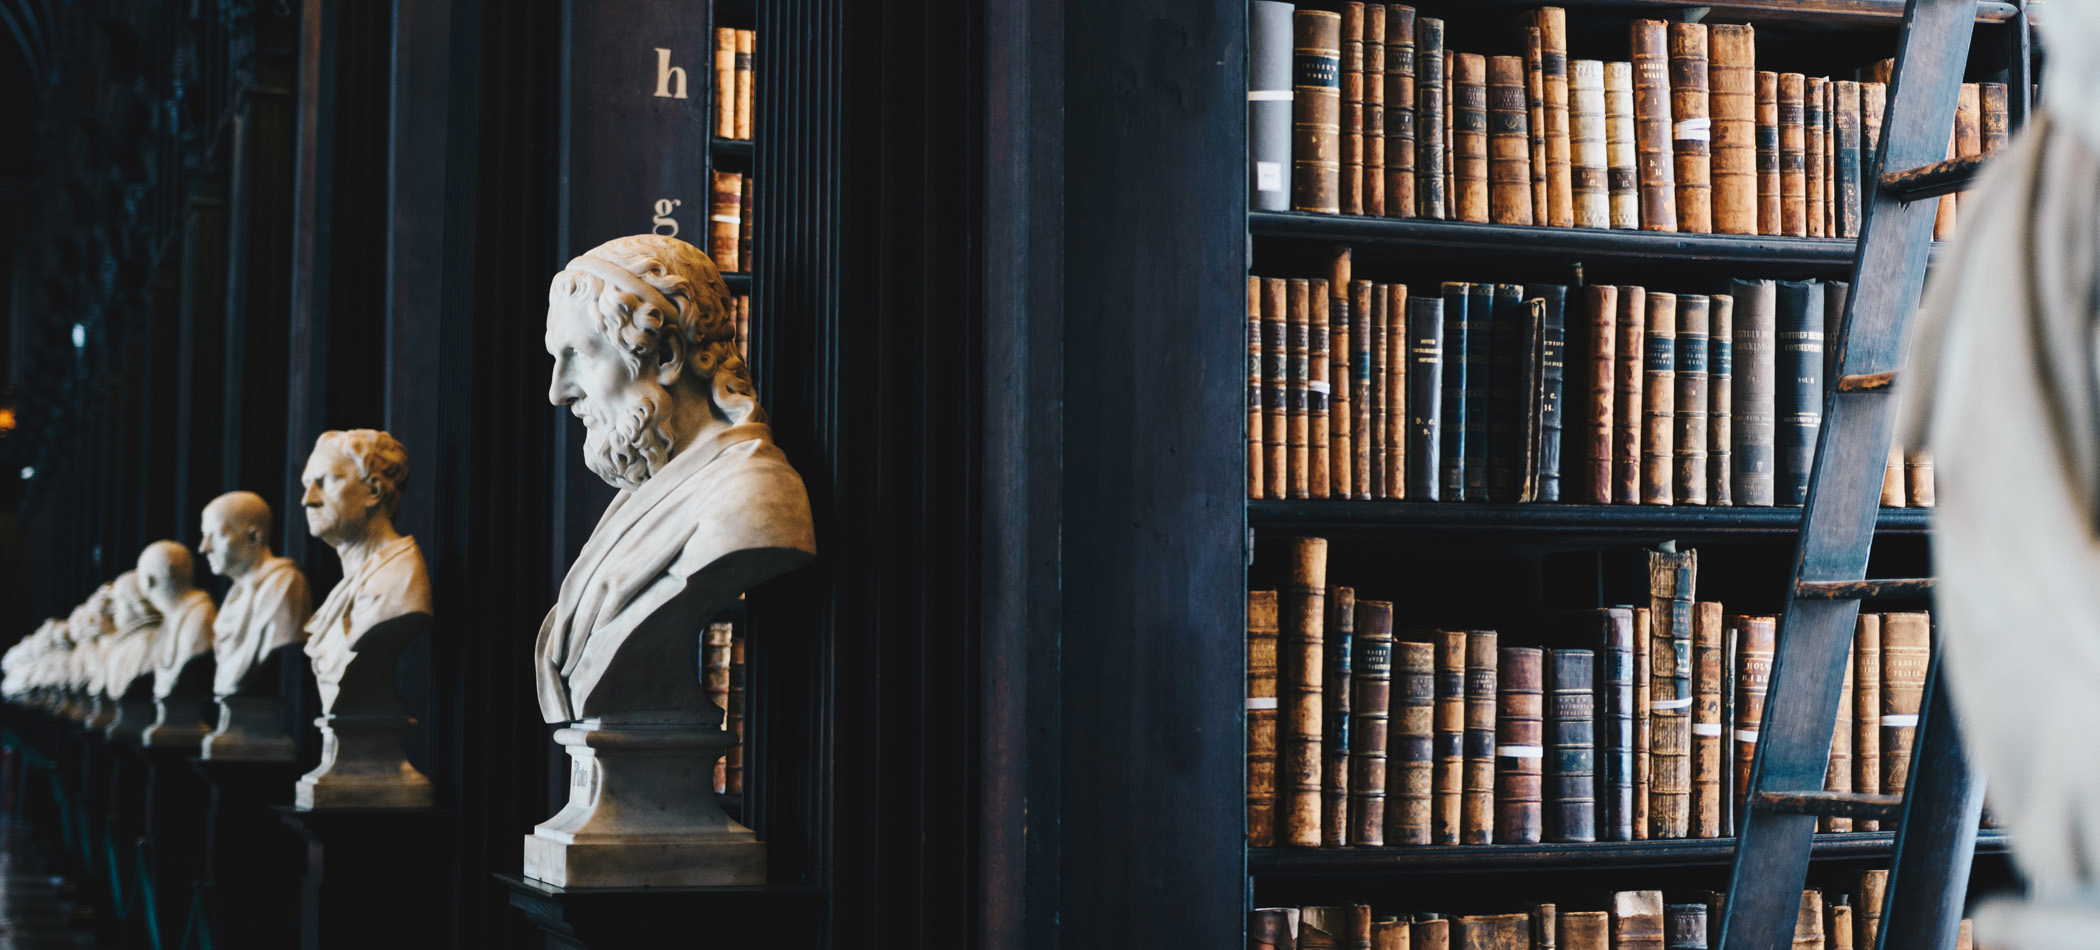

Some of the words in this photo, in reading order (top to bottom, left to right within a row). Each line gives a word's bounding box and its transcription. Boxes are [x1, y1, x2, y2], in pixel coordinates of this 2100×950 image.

[653, 48, 688, 99] h
[653, 198, 681, 237] g
[1741, 674, 1767, 684] BIBL
[573, 760, 587, 787] Plato
